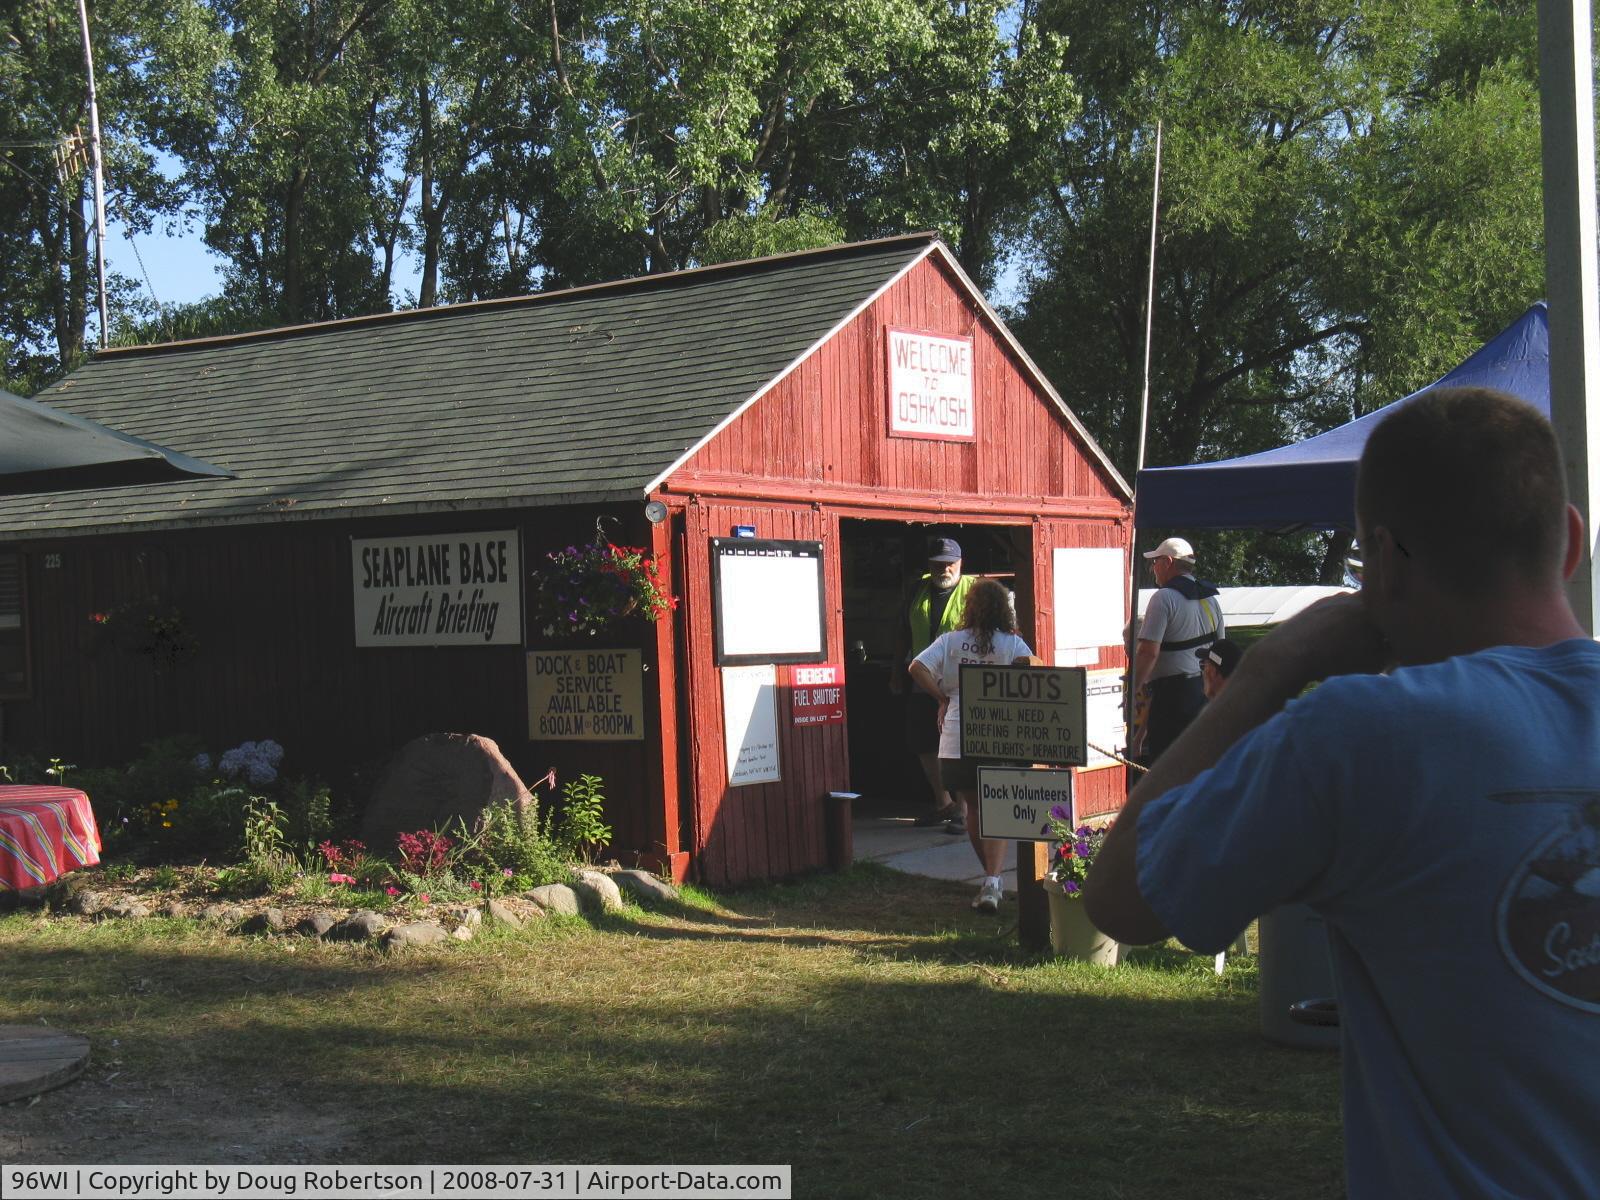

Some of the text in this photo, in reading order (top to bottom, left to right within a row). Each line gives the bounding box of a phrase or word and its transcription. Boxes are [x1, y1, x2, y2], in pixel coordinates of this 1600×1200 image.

[895, 338, 967, 376] WELCOME
[924, 376, 938, 390] TO
[899, 392, 967, 427] OSHKOSH
[362, 541, 508, 588] SEAPLANE BASE
[373, 588, 499, 641] Aircraft Briefing
[535, 655, 573, 675] DOCK
[587, 654, 627, 674] BOAT
[556, 676, 613, 694] SERVICE
[796, 667, 836, 685] EMERGENCY
[983, 671, 1061, 699] PILOTS
[547, 694, 622, 714] AVAILABLE
[794, 688, 840, 707] FUEL SHUTOFF
[794, 716, 809, 725] INSIDE
[817, 714, 828, 722] LEFT
[969, 705, 1060, 723] YOU WILL NEED A
[966, 723, 1071, 741] BRIEFING PRIOR TO
[966, 740, 991, 754] LOCAL
[993, 741, 1025, 757] FLIGHTS
[983, 784, 1068, 802] Dock Volunteers
[1013, 804, 1037, 824] Only
